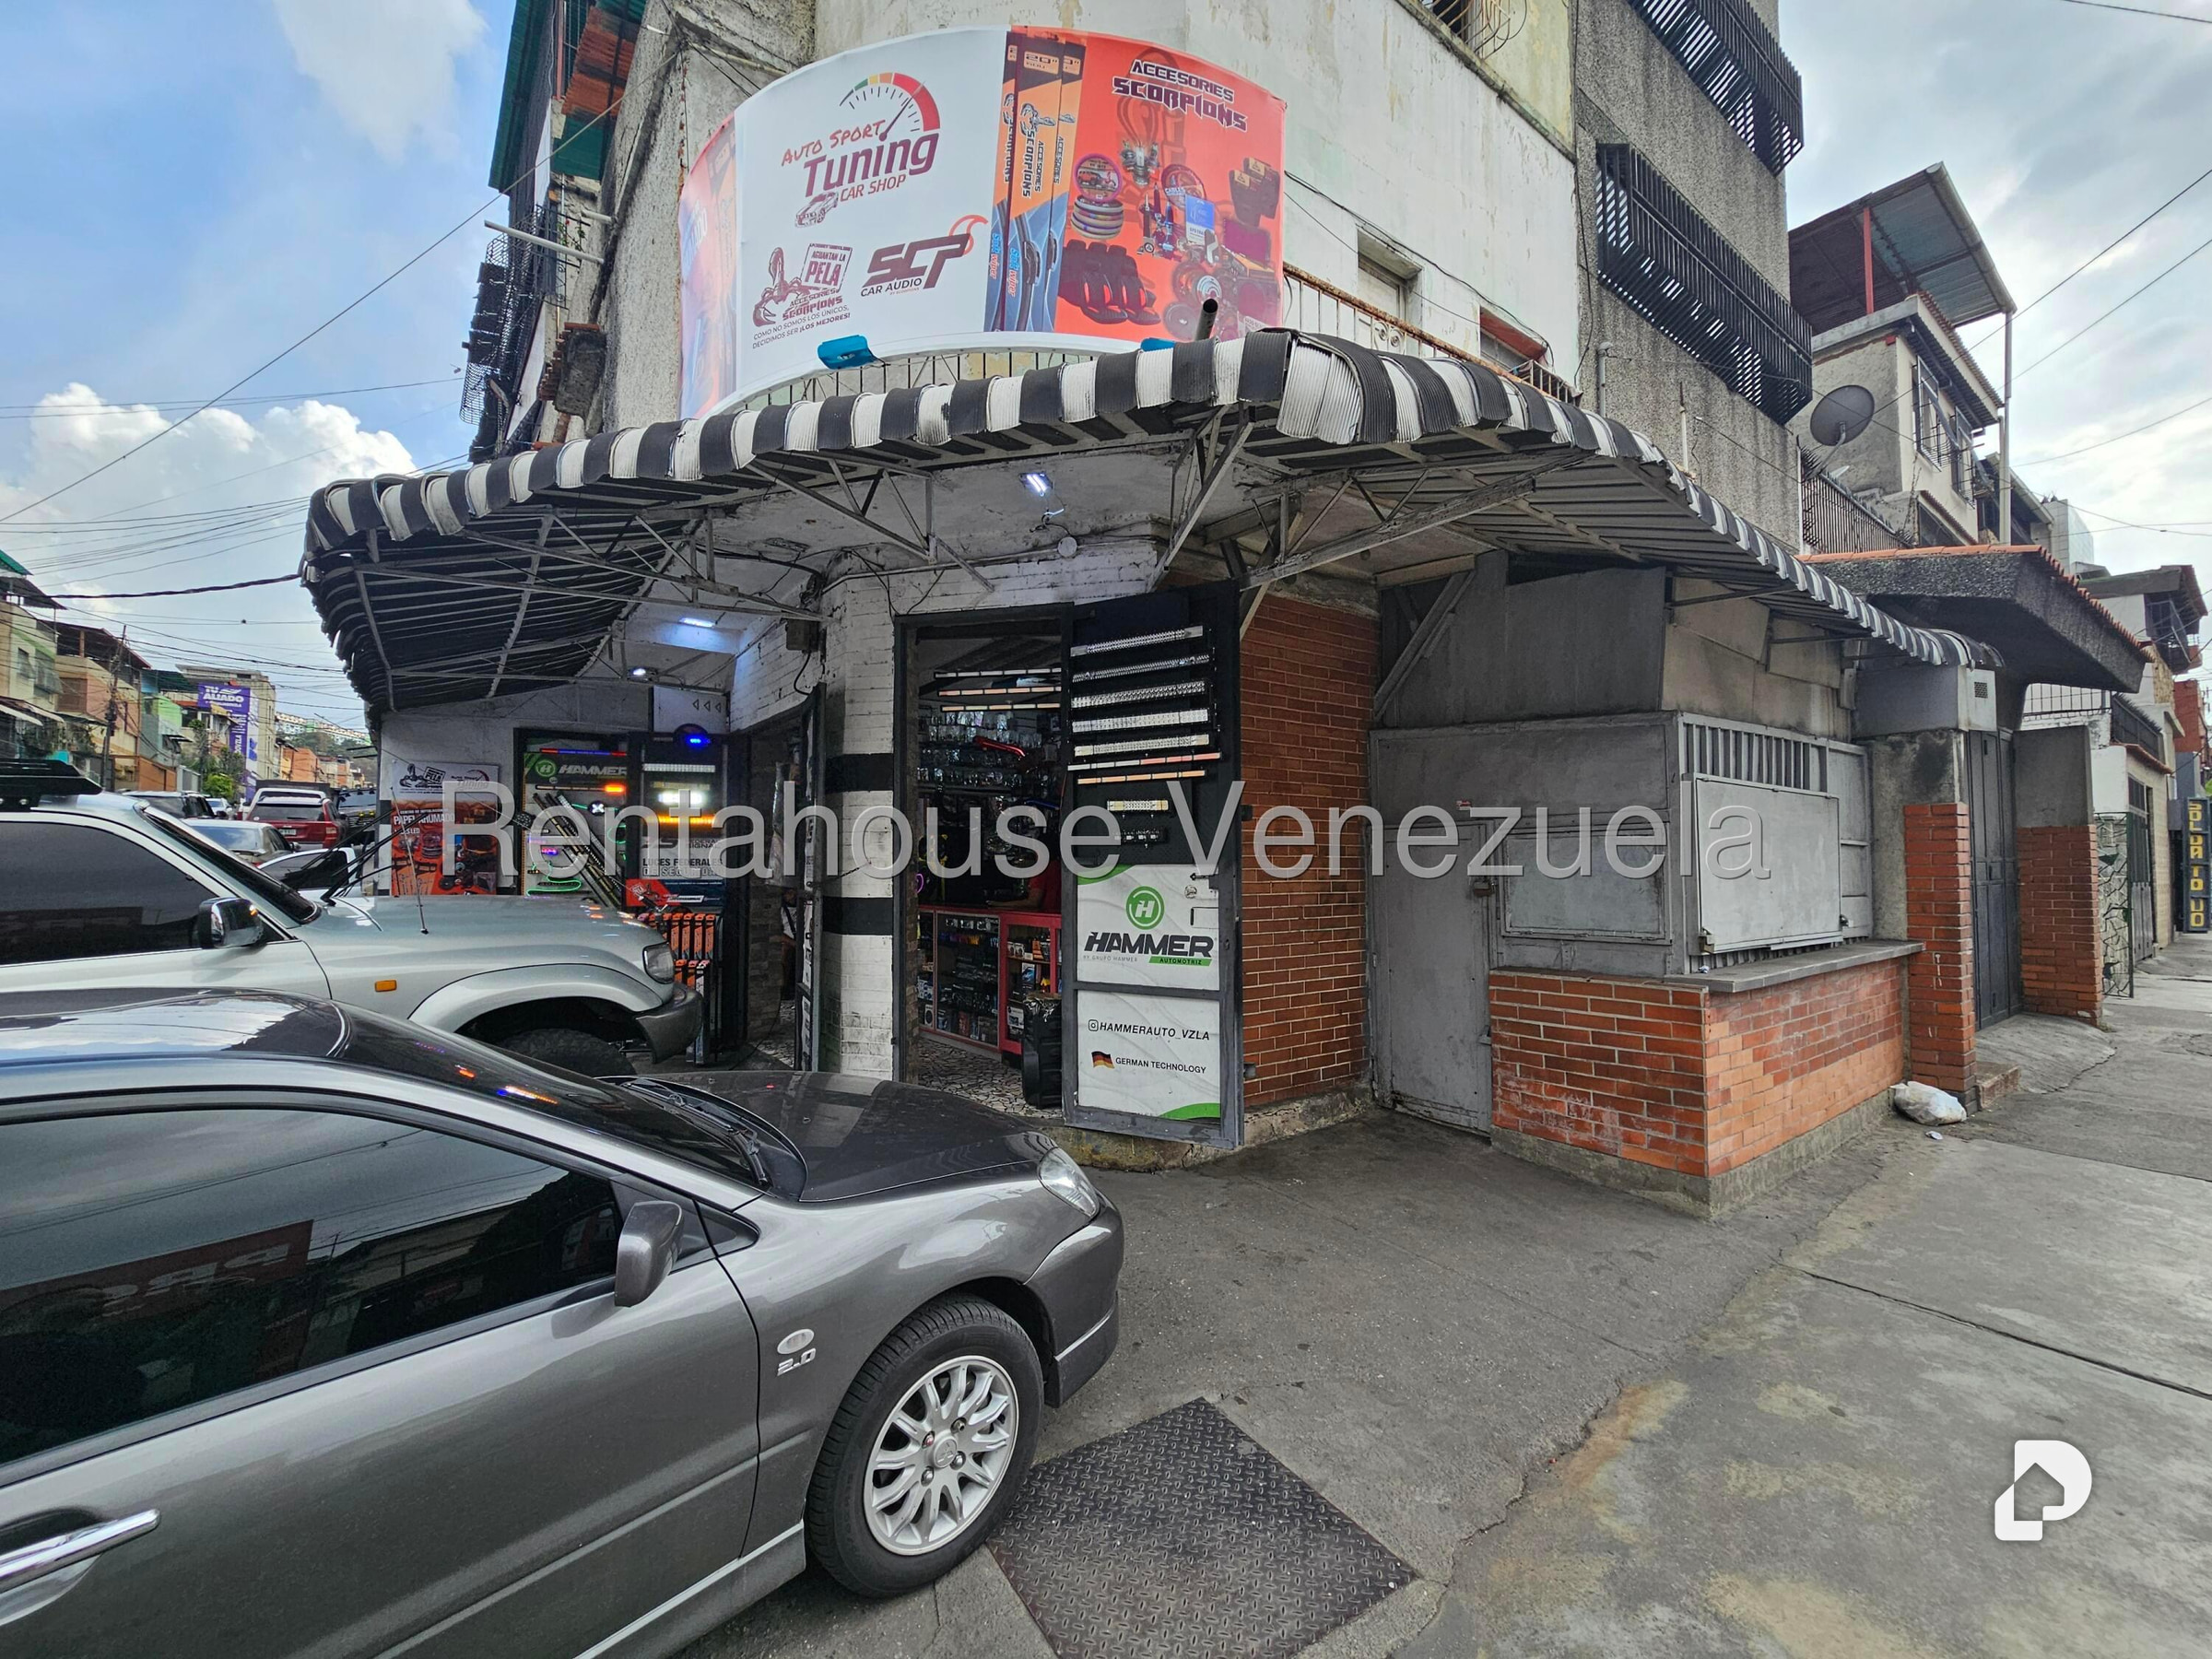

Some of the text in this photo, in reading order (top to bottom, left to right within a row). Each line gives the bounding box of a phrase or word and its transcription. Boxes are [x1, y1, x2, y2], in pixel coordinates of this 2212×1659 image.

[1130, 59, 1234, 103] ACCESORIES
[1112, 76, 1248, 132] SCORPIONS
[804, 133, 940, 197] Tuning
[1022, 129, 1036, 199] SCORPIONS
[1035, 140, 1045, 192] ACCESORIES
[840, 173, 907, 202] CAR SHOP
[805, 261, 841, 286] PELA
[861, 277, 922, 297] CAR AUDIO
[782, 296, 843, 321] SCORPIONS
[752, 331, 786, 349] DECIDIMOS
[786, 327, 798, 336] SER
[816, 312, 851, 326] MEJORES!
[754, 327, 772, 340] COMO
[773, 324, 782, 333] NO
[783, 318, 806, 330] SOMOS
[807, 312, 820, 322] LOS
[203, 692, 244, 703] ALIADO
[642, 857, 671, 866] LUCES
[1084, 931, 1214, 959] HAMMER
[1159, 958, 1202, 966] AUTOMOTRIZ
[1100, 1022, 1210, 1041] HAMMERAUTO_VZLA
[1115, 1057, 1206, 1074] GERMAN TECHNOLOGY
[777, 1347, 817, 1377] 2.0
